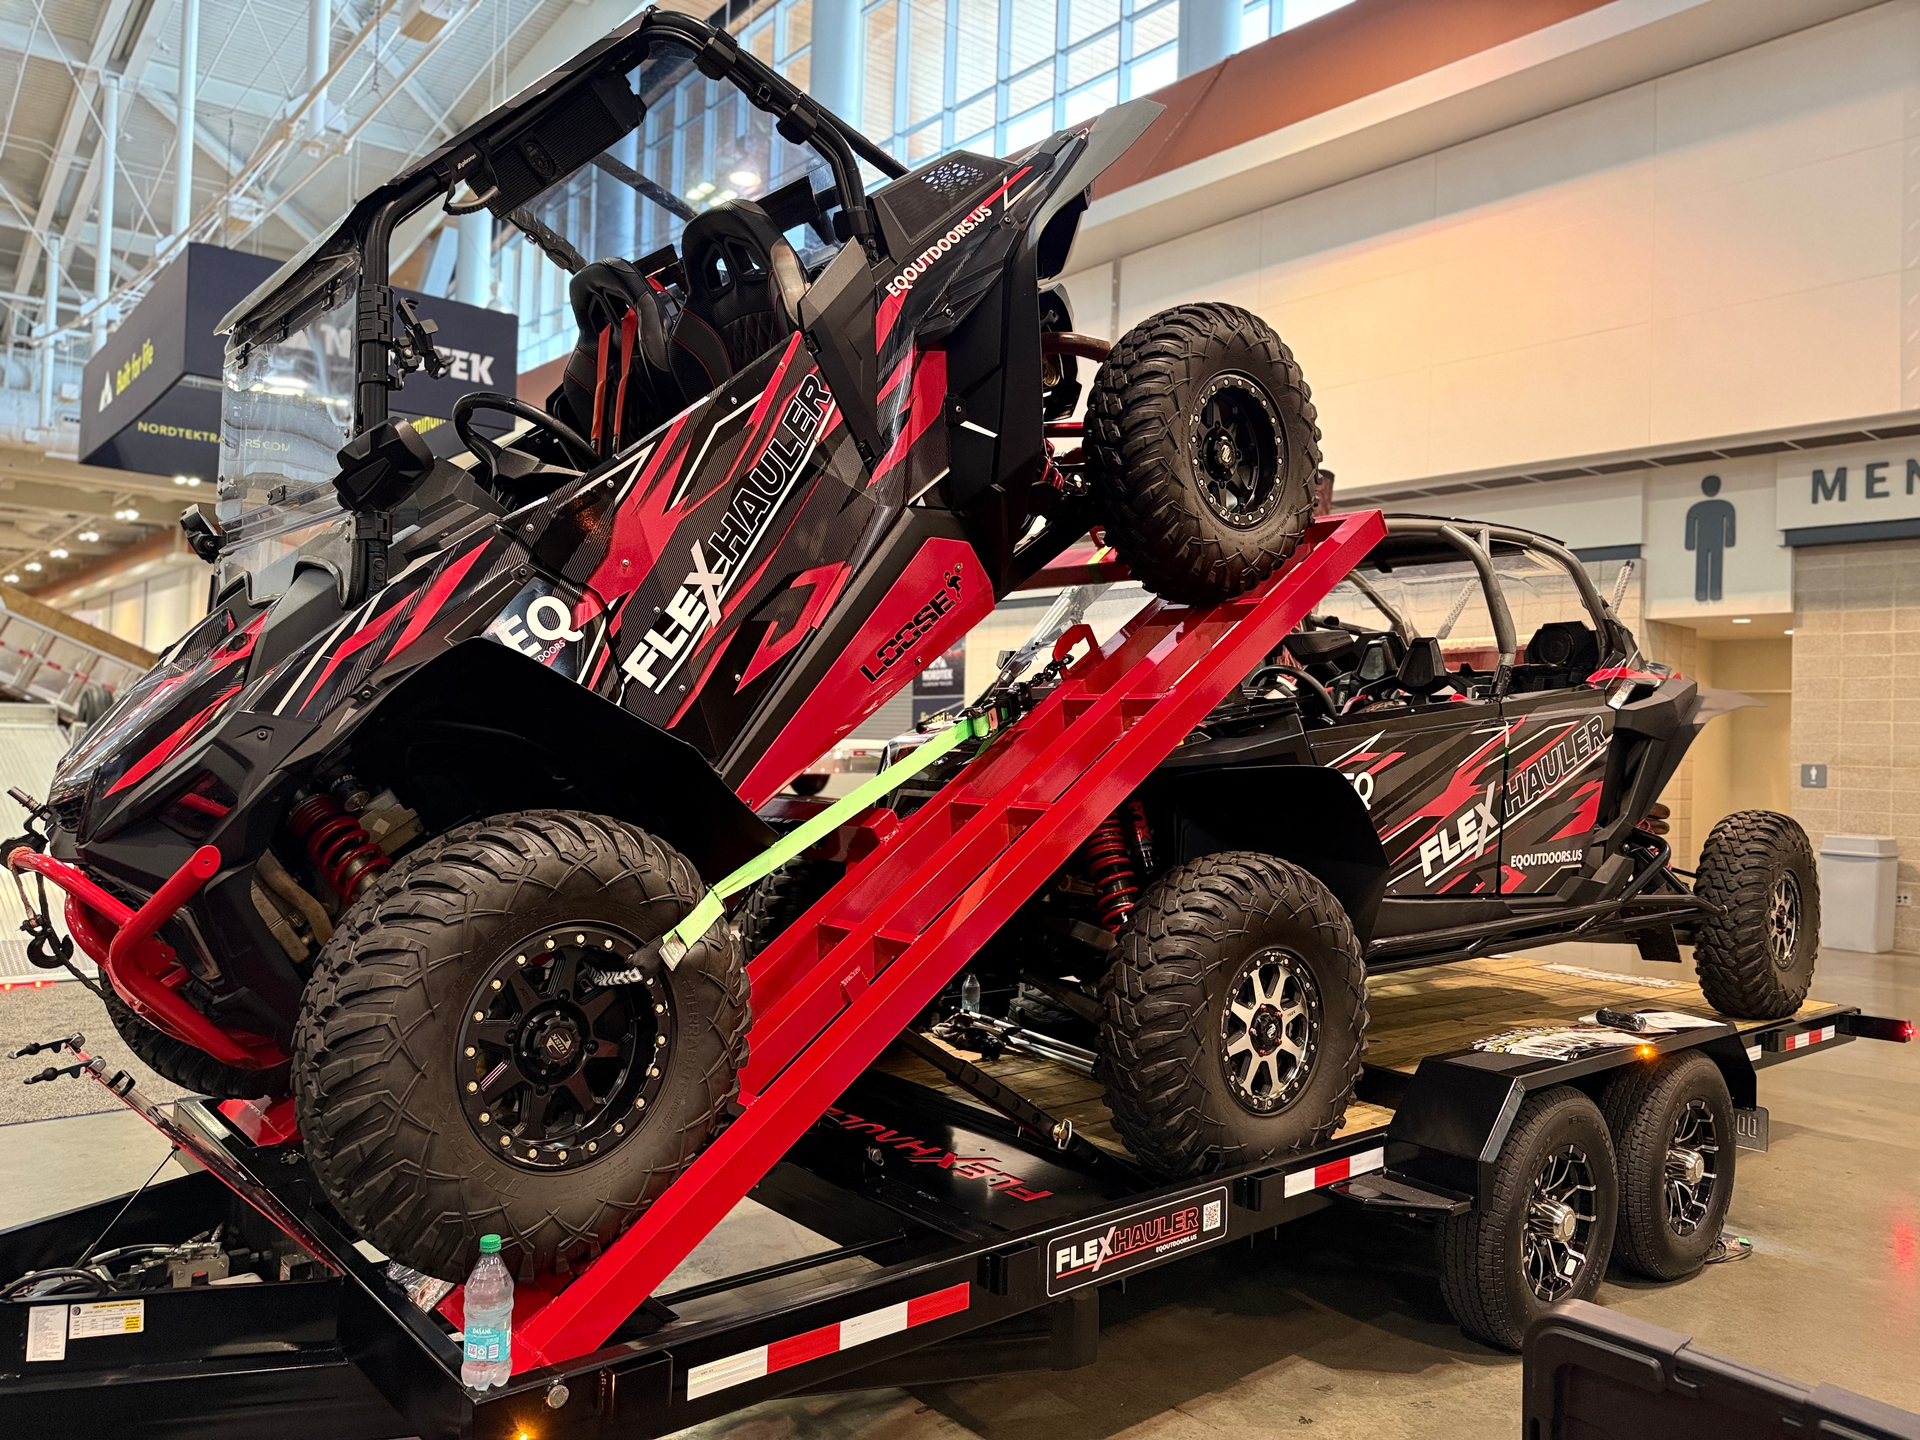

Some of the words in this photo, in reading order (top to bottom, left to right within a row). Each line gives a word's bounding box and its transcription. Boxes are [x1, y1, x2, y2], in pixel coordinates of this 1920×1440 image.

[885, 205, 993, 298] EQOUTDOORS.US
[707, 373, 832, 565] HAULER
[494, 595, 584, 658] EQ
[621, 539, 727, 689] FLEX
[859, 588, 956, 683] LOOSE
[1419, 780, 1499, 878] FLEX
[1504, 714, 1607, 818] HAULER
[1510, 849, 1583, 868] EQOUTDOORS.US
[551, 1033, 568, 1055] TUSK
[905, 1152, 1054, 1202] FLEX
[1055, 1225, 1117, 1274] FLEX
[1113, 1206, 1199, 1255] HAULER
[1155, 1233, 1198, 1253] EQOUTDOORS.US
